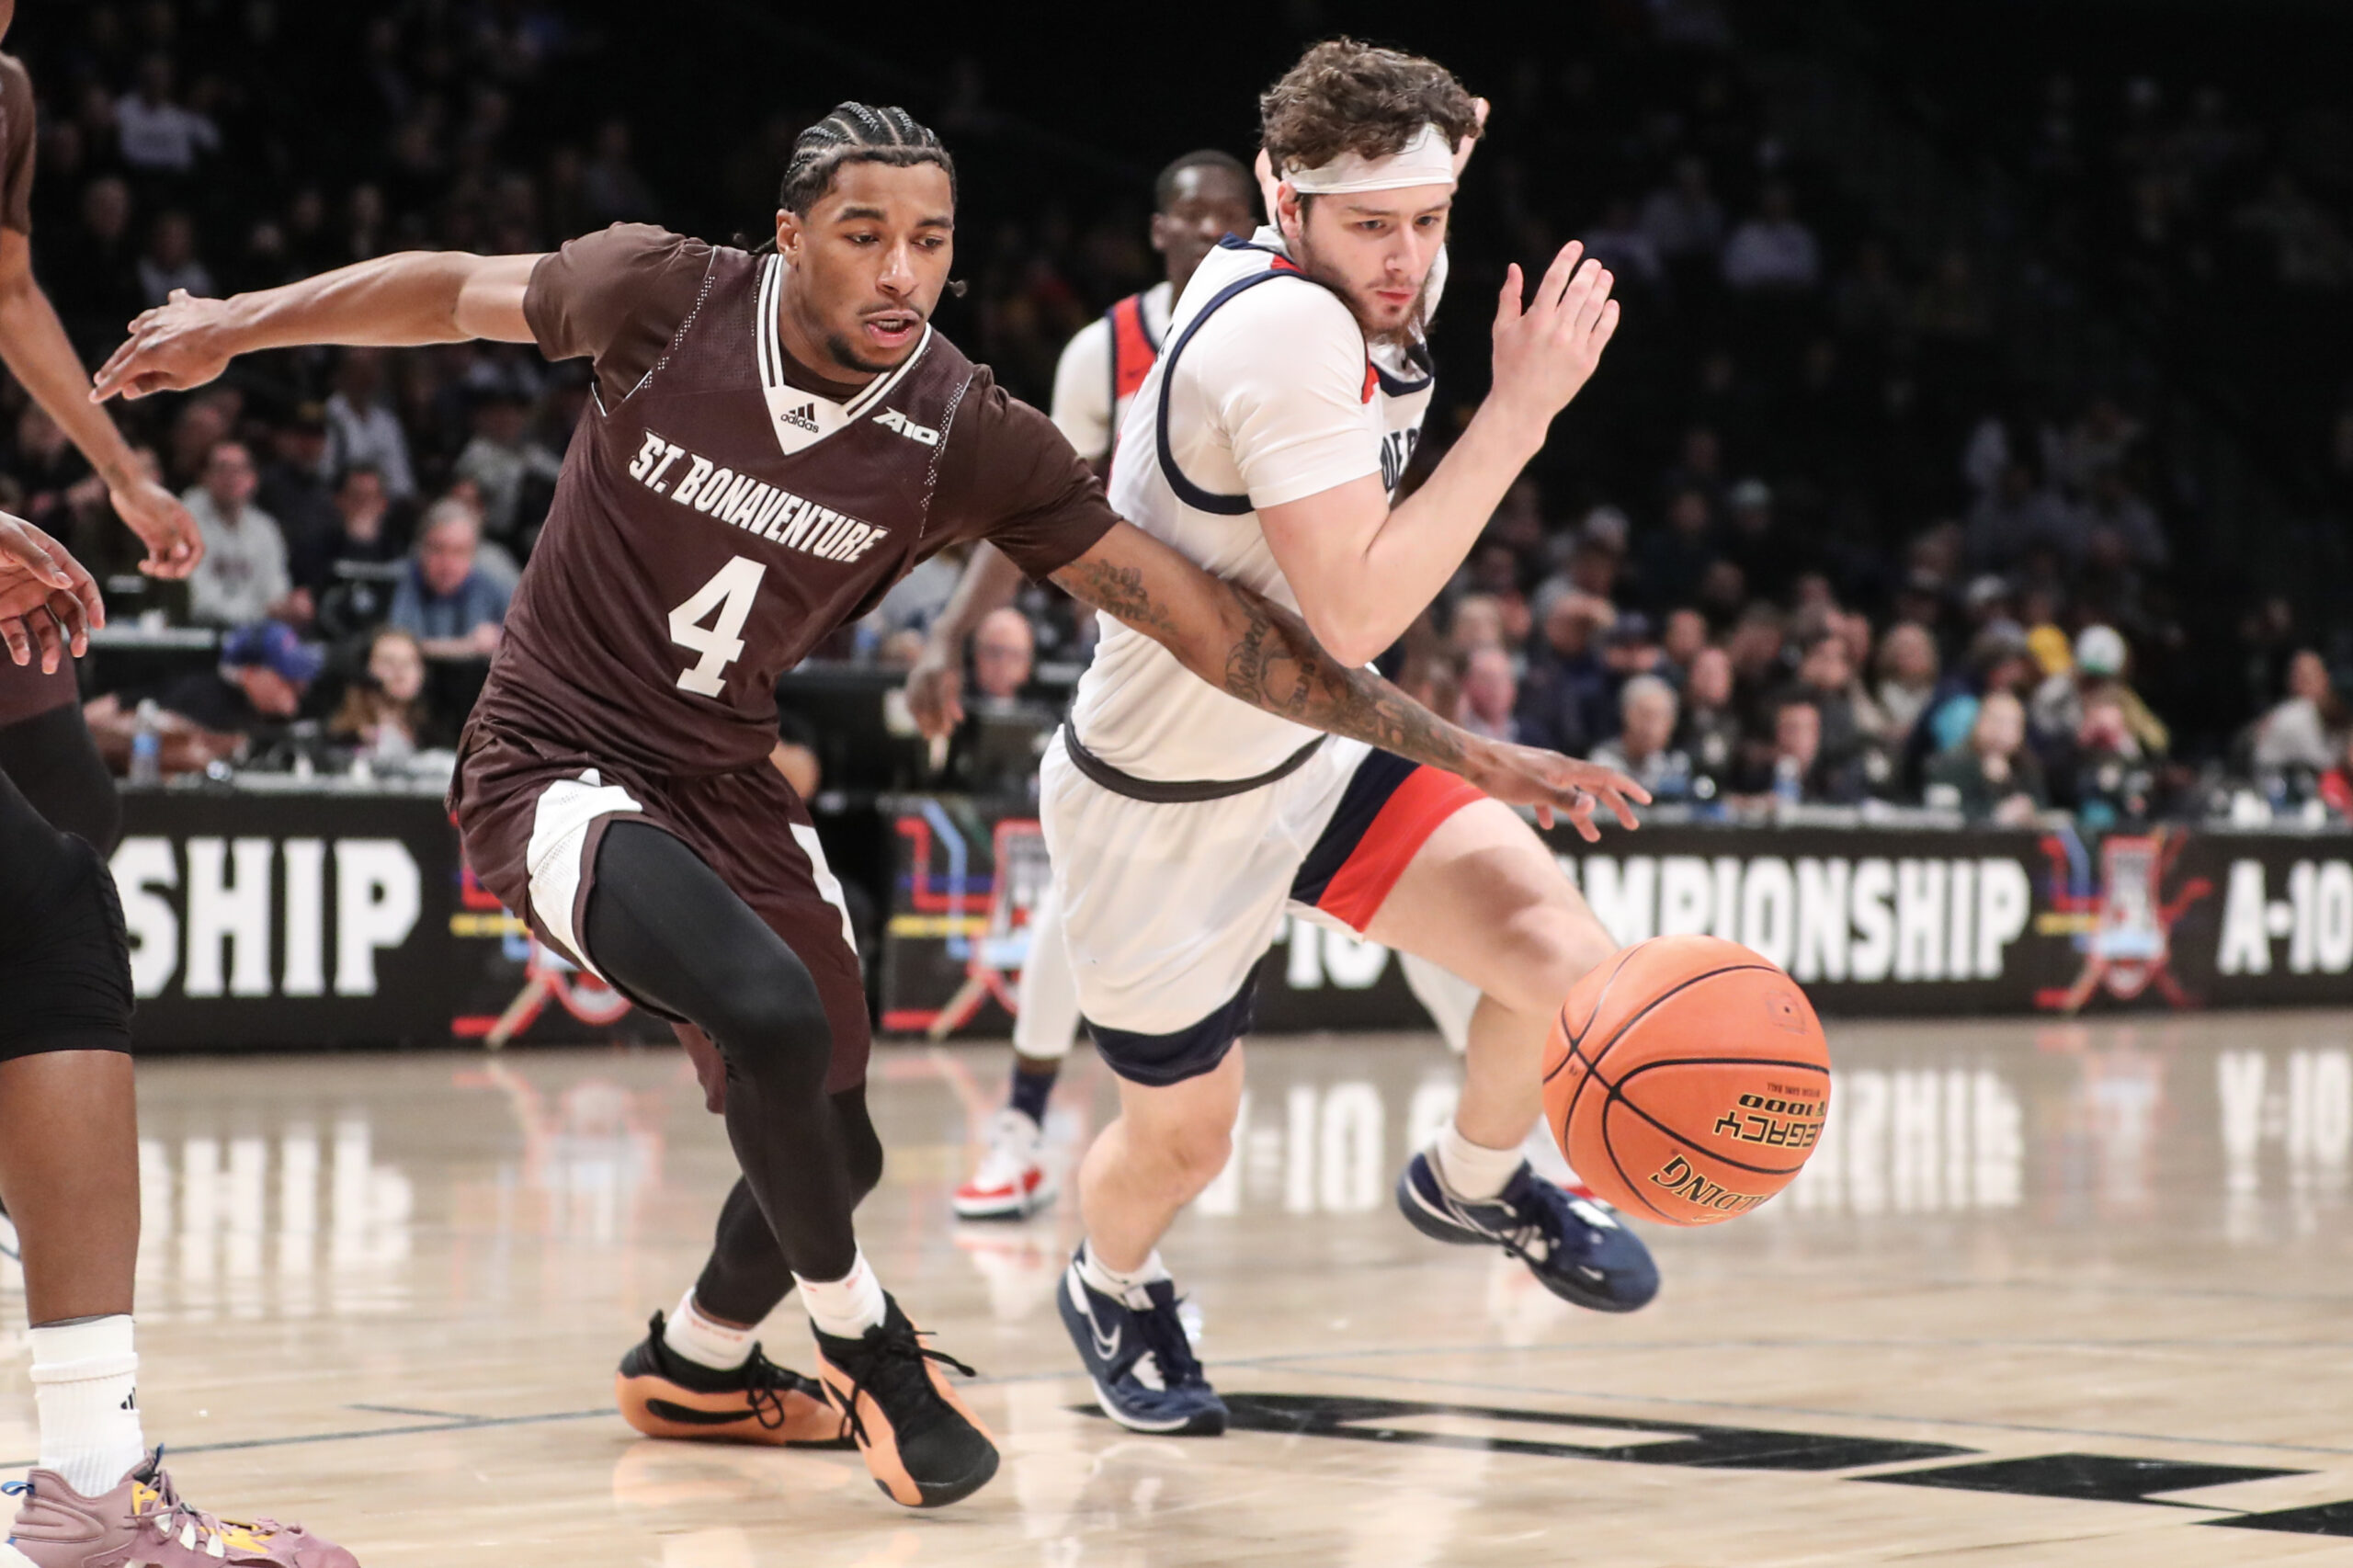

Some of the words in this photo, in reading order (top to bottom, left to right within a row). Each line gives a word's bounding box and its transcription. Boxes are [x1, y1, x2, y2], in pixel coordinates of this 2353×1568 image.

[780, 414, 820, 434] adidas
[872, 405, 940, 447] A10
[629, 431, 687, 494] ST.
[671, 454, 889, 563] BONAVENTURE
[668, 555, 767, 698] 4
[1560, 854, 2031, 983] MPIONSHIP
